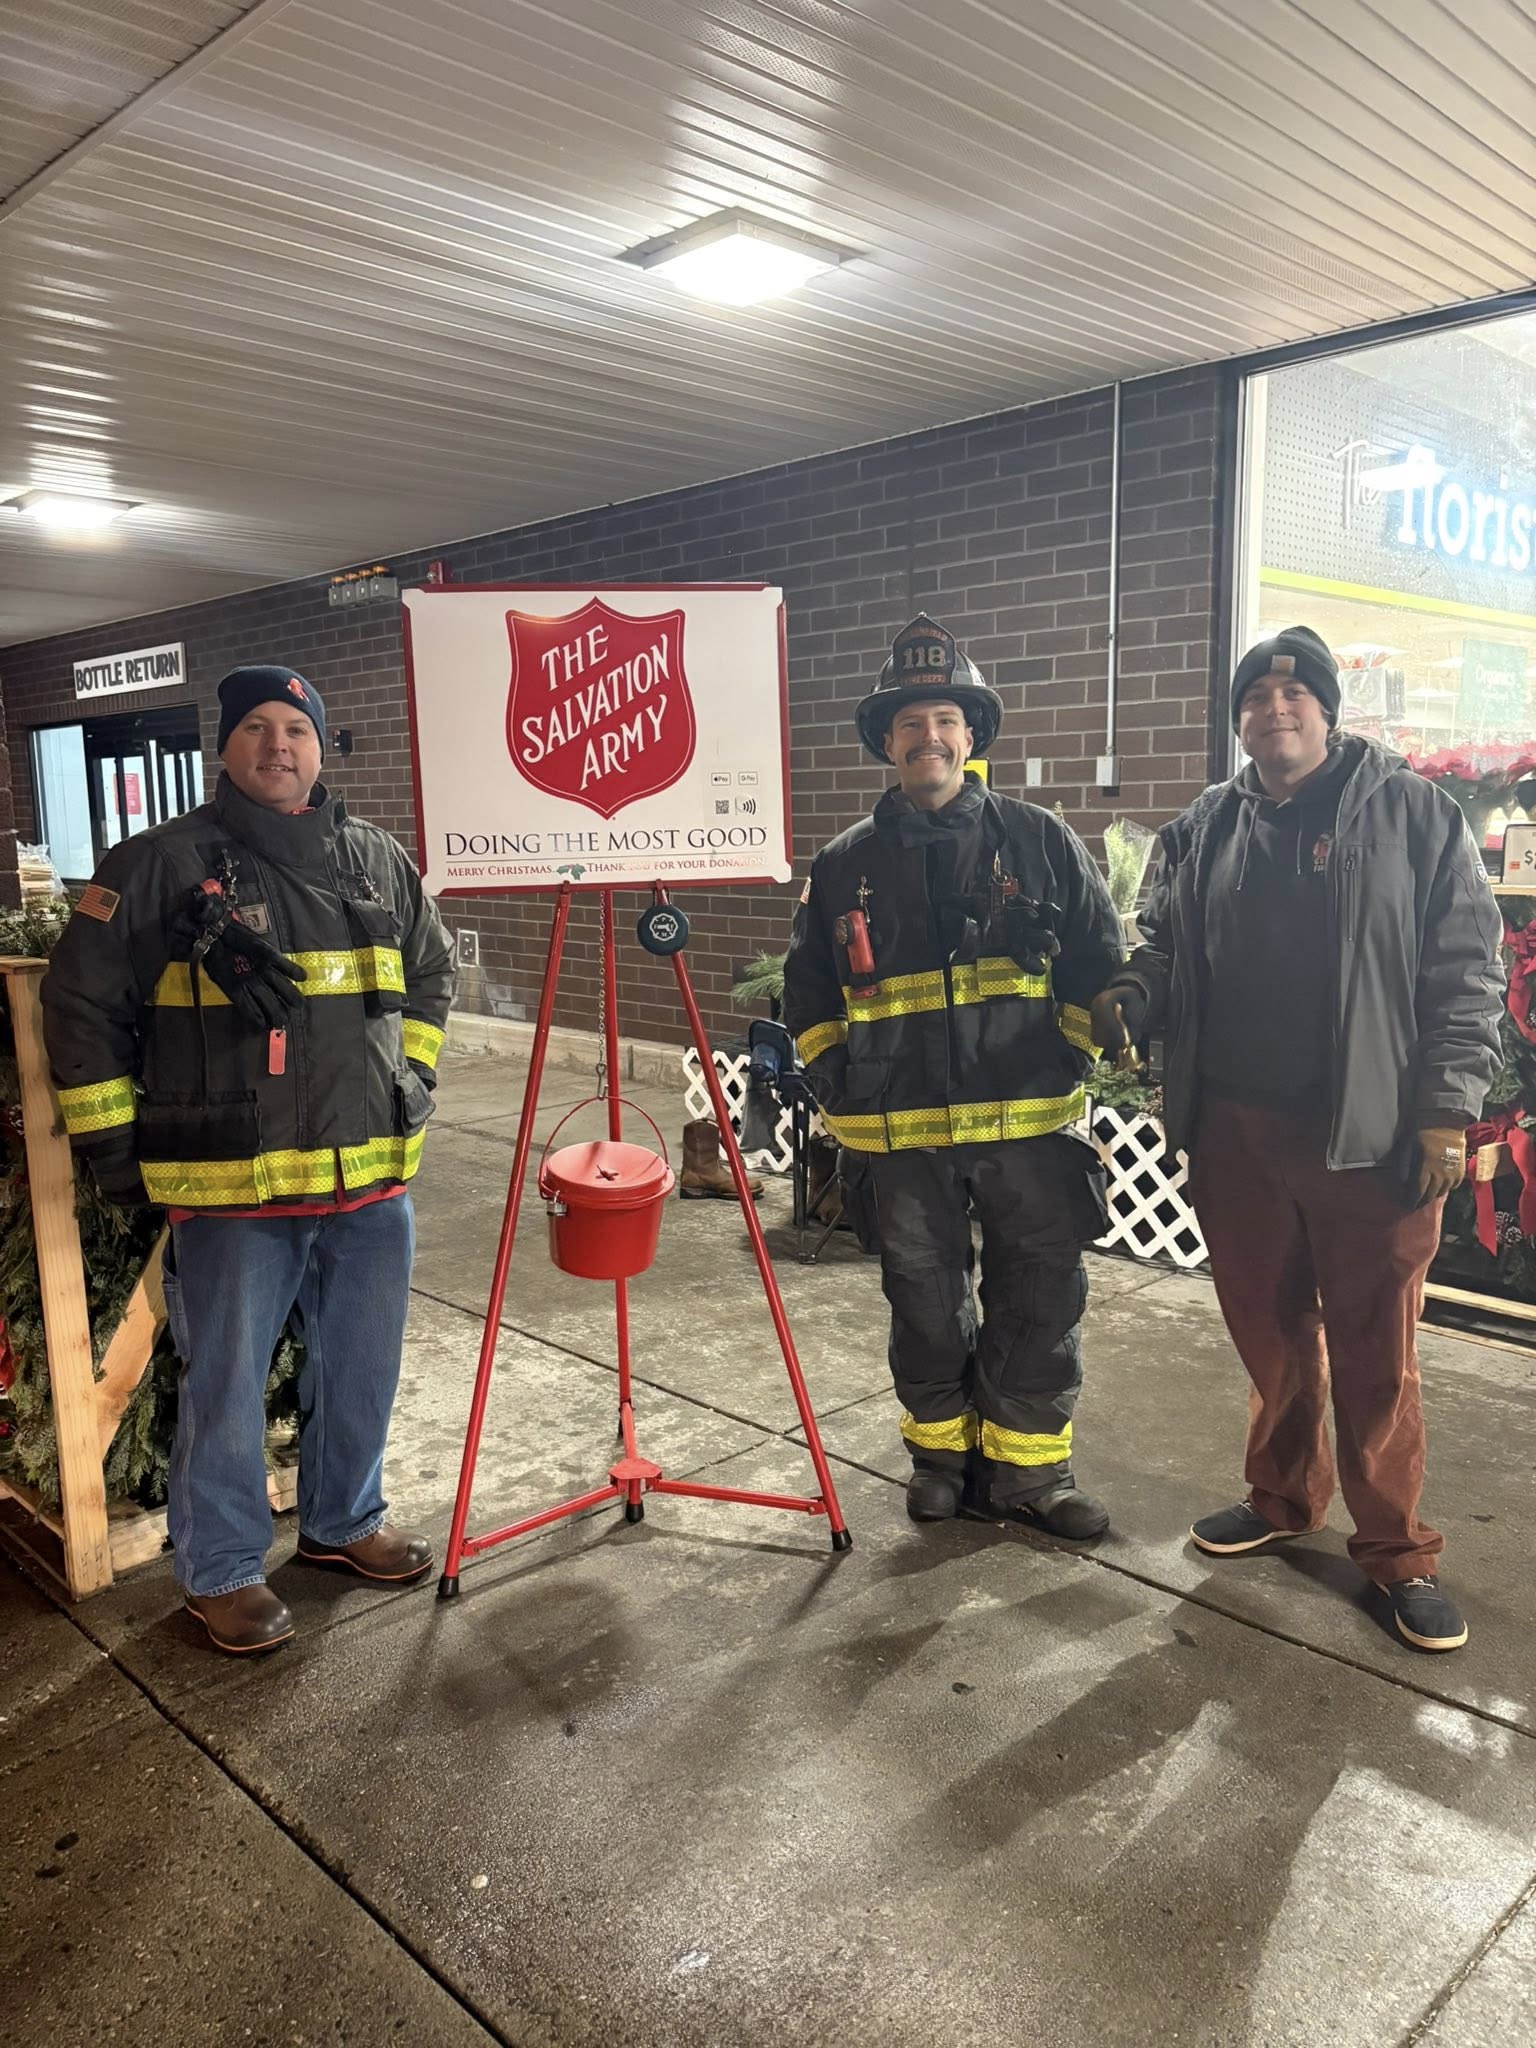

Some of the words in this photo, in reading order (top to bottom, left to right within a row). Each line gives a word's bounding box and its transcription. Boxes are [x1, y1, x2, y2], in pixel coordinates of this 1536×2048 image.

[1397, 443, 1536, 572] floris
[75, 661, 124, 692] BOTTLE
[125, 651, 180, 684] RETURN
[541, 624, 609, 691] THE
[903, 646, 946, 670] 118
[522, 633, 670, 763] SALVATION
[580, 694, 667, 791] ARMY
[444, 832, 541, 856] DOING
[547, 831, 600, 852] THE
[608, 829, 680, 851] MOST
[687, 826, 767, 849] GOOD
[447, 867, 485, 877] MERRY
[586, 863, 626, 873] THANK
[654, 861, 675, 870] FOR
[678, 859, 706, 869] YOUR
